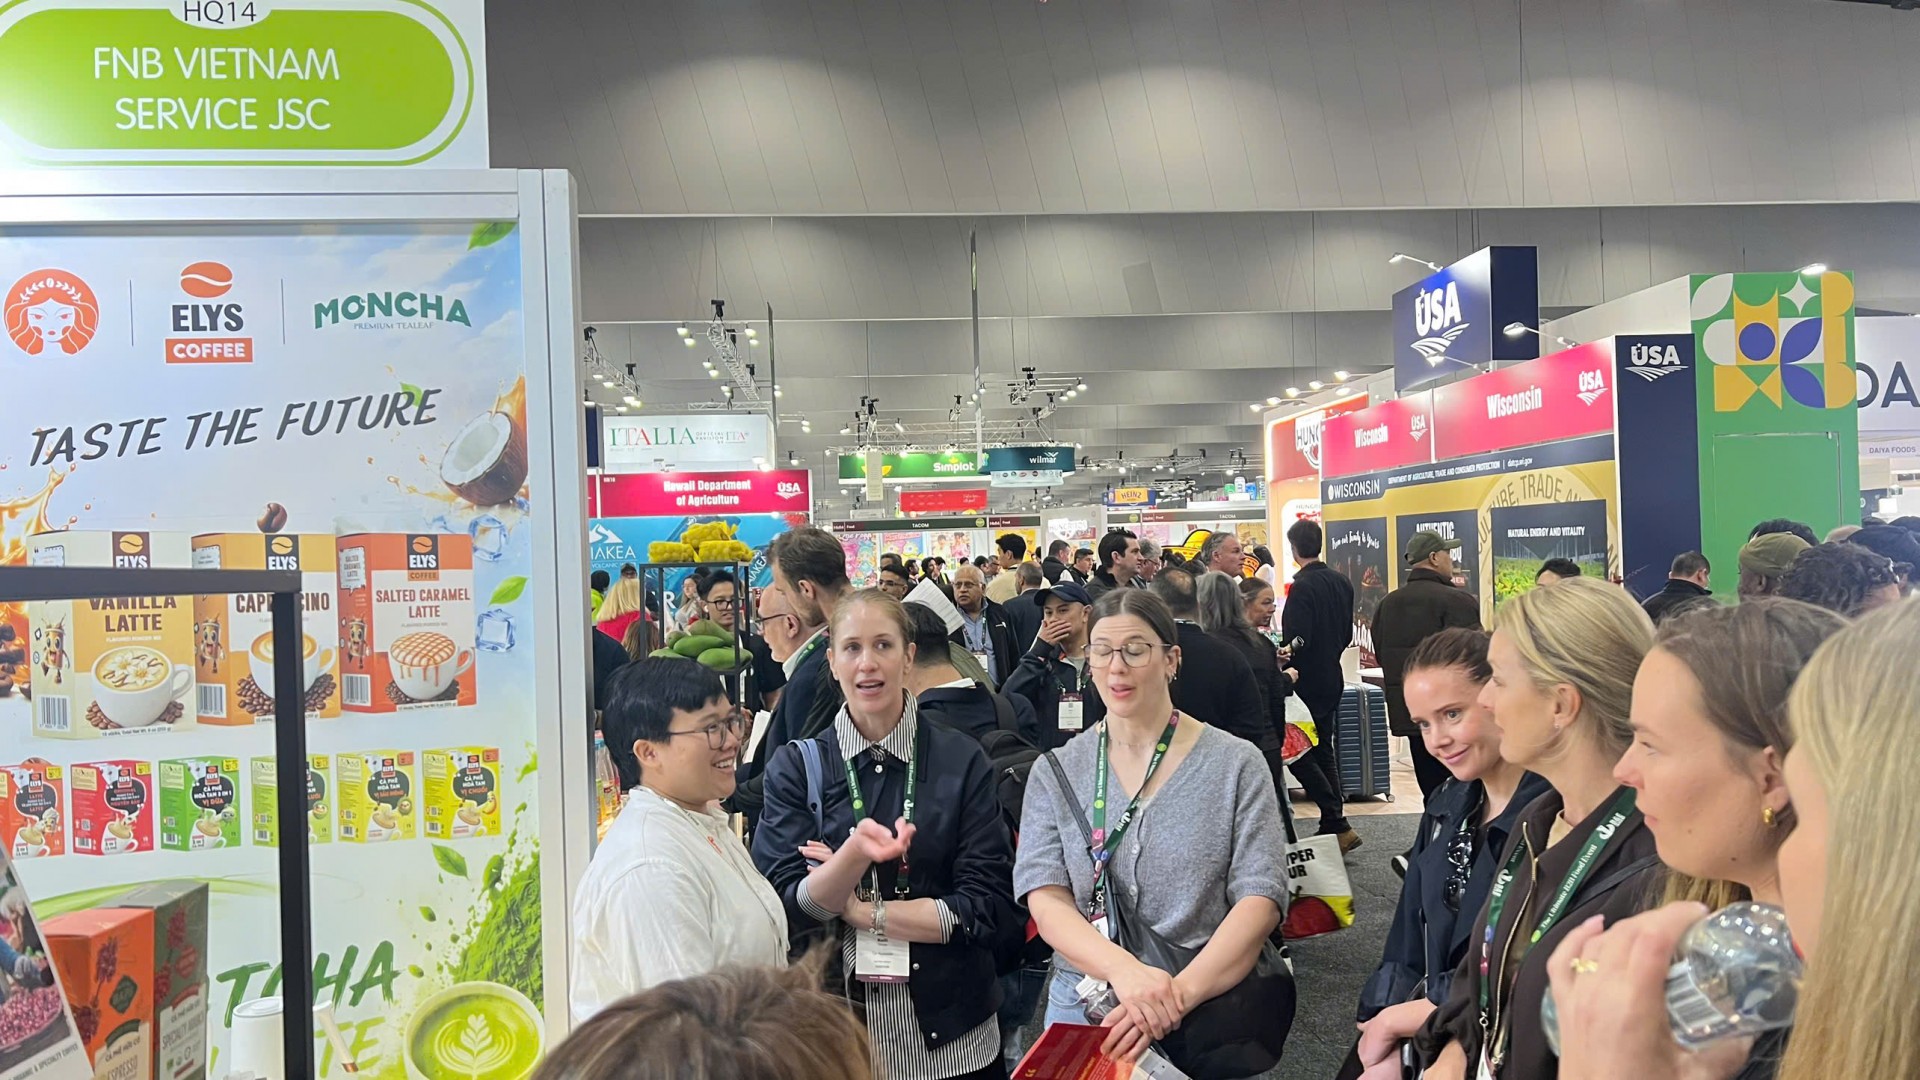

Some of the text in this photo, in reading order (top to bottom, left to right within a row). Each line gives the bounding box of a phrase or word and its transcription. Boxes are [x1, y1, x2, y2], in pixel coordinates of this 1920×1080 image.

[183, 0, 257, 24] HQ14
[94, 47, 340, 80] FNB VIETNAM
[115, 97, 332, 131] SERVICE JSC
[314, 291, 472, 330] MONCHA
[1415, 281, 1462, 337] USA
[172, 303, 244, 333] ELYS
[354, 322, 434, 330] PREMIUM TEALEAF
[173, 343, 245, 359] COFFEE
[1631, 344, 1680, 367] USA
[1578, 369, 1604, 391] USA
[1487, 385, 1543, 420] Wisconsin
[29, 388, 442, 467] TASTE THE FUTURE
[1411, 414, 1426, 431] USA
[609, 427, 696, 446] ITALIA
[1354, 422, 1389, 449] Wisconsin
[1891, 446, 1916, 454] FOODS
[933, 461, 975, 472] Simplot
[1029, 455, 1057, 464] wilmar
[698, 479, 752, 494] Department
[777, 481, 801, 492] USA
[1120, 490, 1142, 499] HEINZ
[1334, 479, 1380, 499] WISCONSIN
[1520, 473, 1563, 502] TRADE
[676, 494, 740, 507] of Agriculture
[1507, 526, 1585, 538] NATURAL ENERGY AND VITALITY
[115, 555, 148, 568] ELYS
[268, 556, 297, 570] ELYS
[409, 554, 437, 568] ELYS
[90, 596, 177, 610] VANILLA
[236, 592, 329, 613] CAPPCINO
[376, 588, 470, 602] SALTED CARAMEL
[408, 605, 441, 618] LATTE
[105, 614, 162, 632] LATTE
[1540, 914, 1552, 928] The
[1548, 889, 1568, 916] Ultimate
[1572, 861, 1587, 879] Food
[1581, 844, 1597, 864] Event
